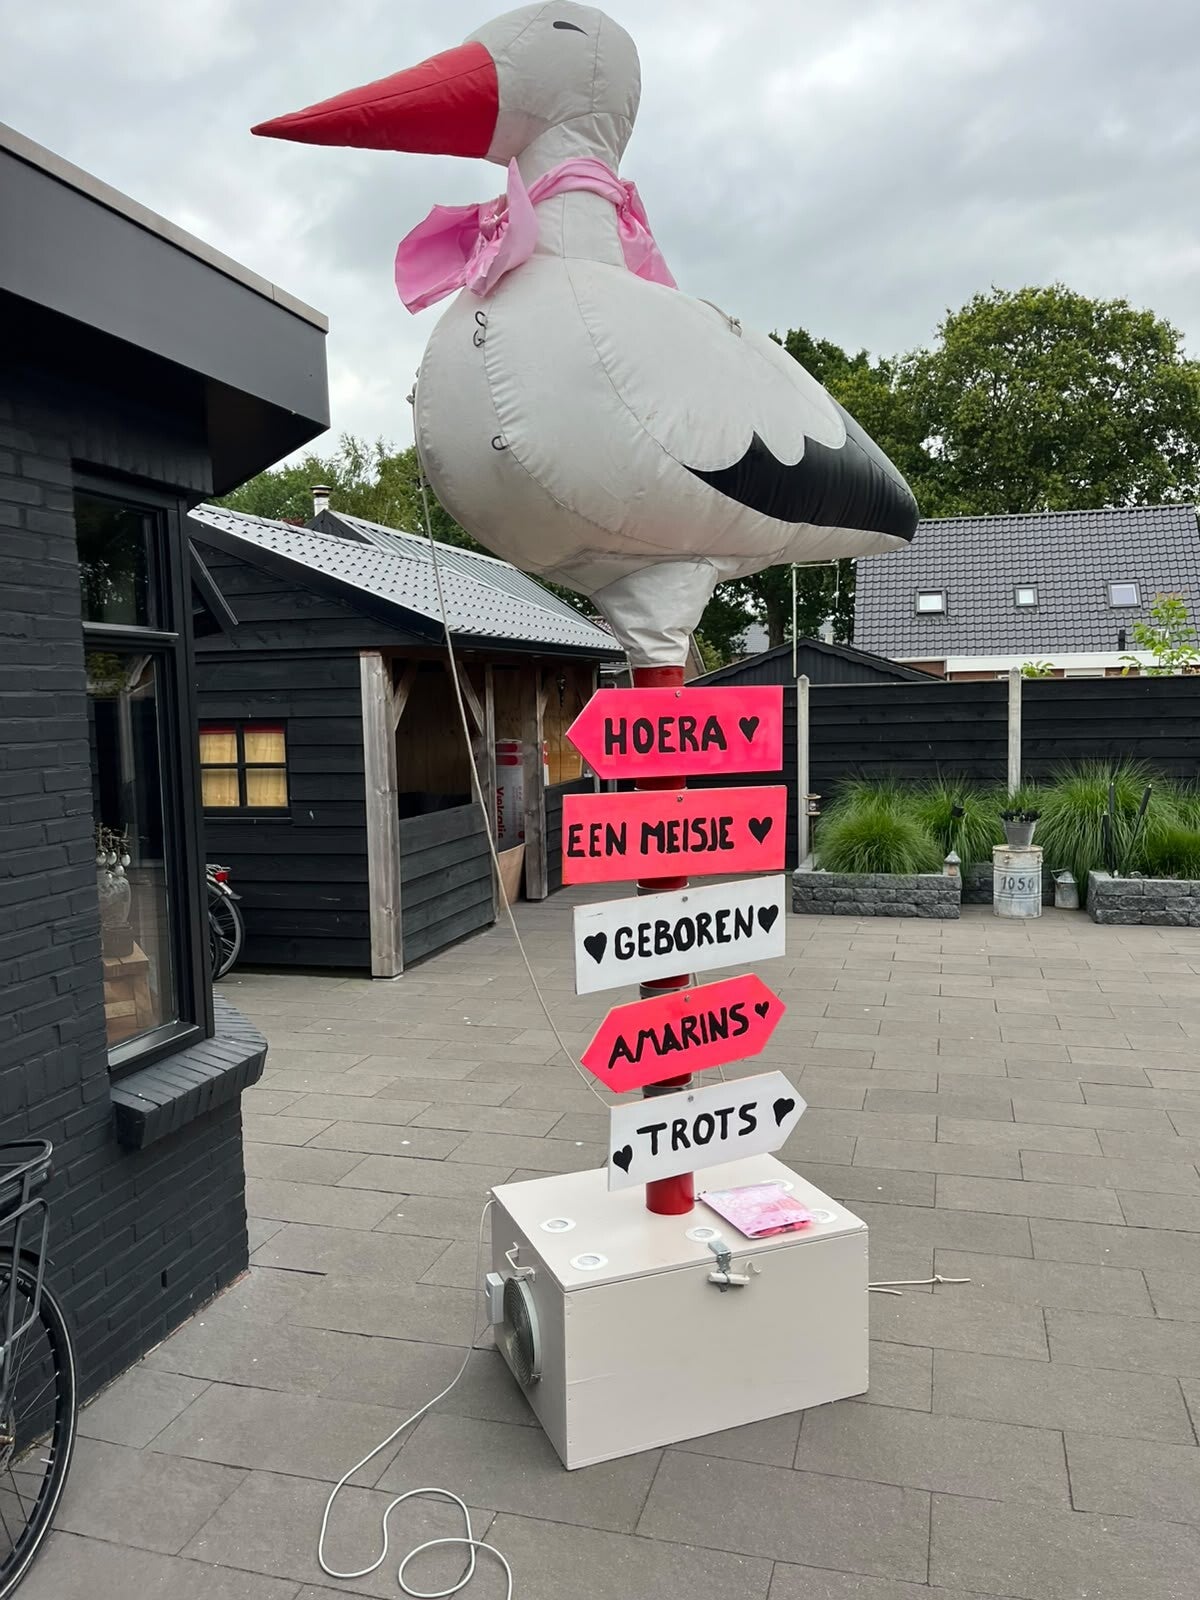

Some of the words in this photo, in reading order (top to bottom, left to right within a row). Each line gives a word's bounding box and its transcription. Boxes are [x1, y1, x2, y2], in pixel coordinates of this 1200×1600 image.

[604, 715, 727, 755] HOERA
[567, 822, 627, 857] EEN
[640, 816, 735, 855] MEISJE
[614, 904, 754, 961] GEBOREN
[608, 1002, 750, 1069] AMARINS
[636, 1101, 758, 1156] TROTS
